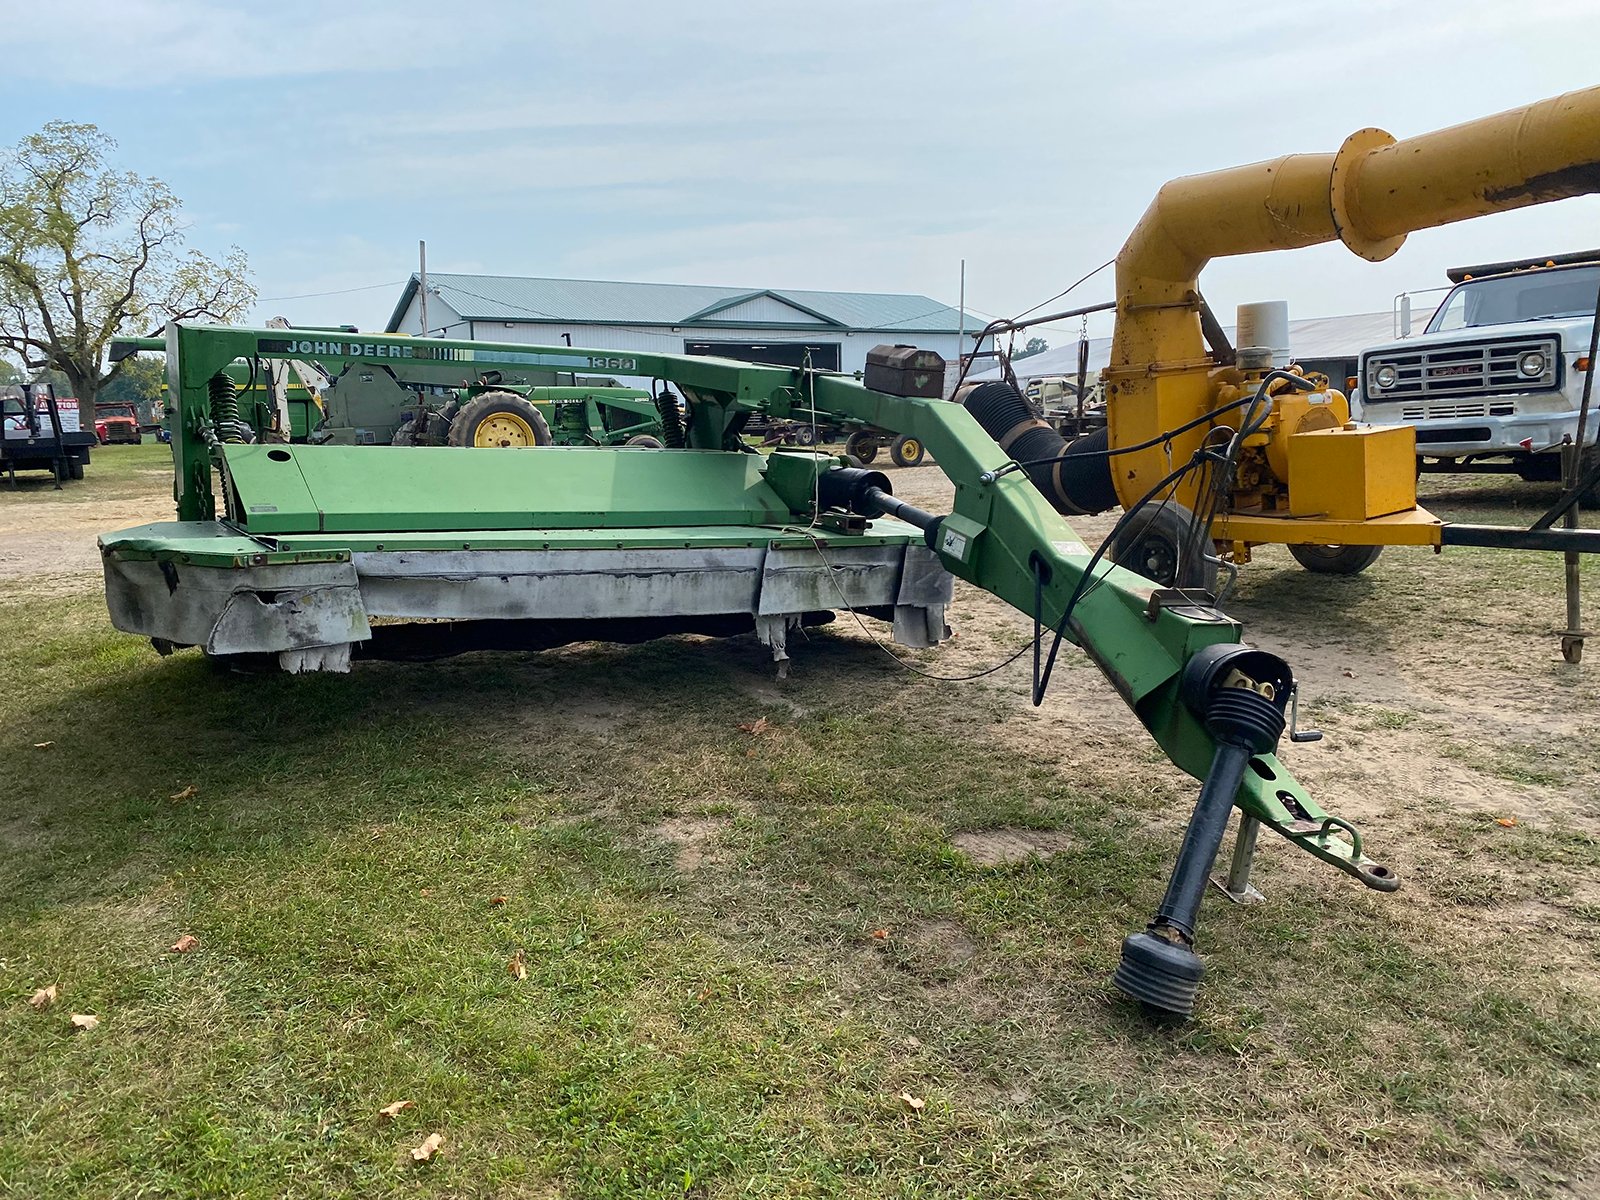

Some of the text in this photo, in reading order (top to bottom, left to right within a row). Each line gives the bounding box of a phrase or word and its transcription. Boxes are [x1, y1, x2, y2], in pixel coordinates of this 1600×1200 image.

[287, 341, 413, 358] JOHN DEERE
[587, 356, 634, 369] 1360
[1432, 365, 1479, 376] GMC
